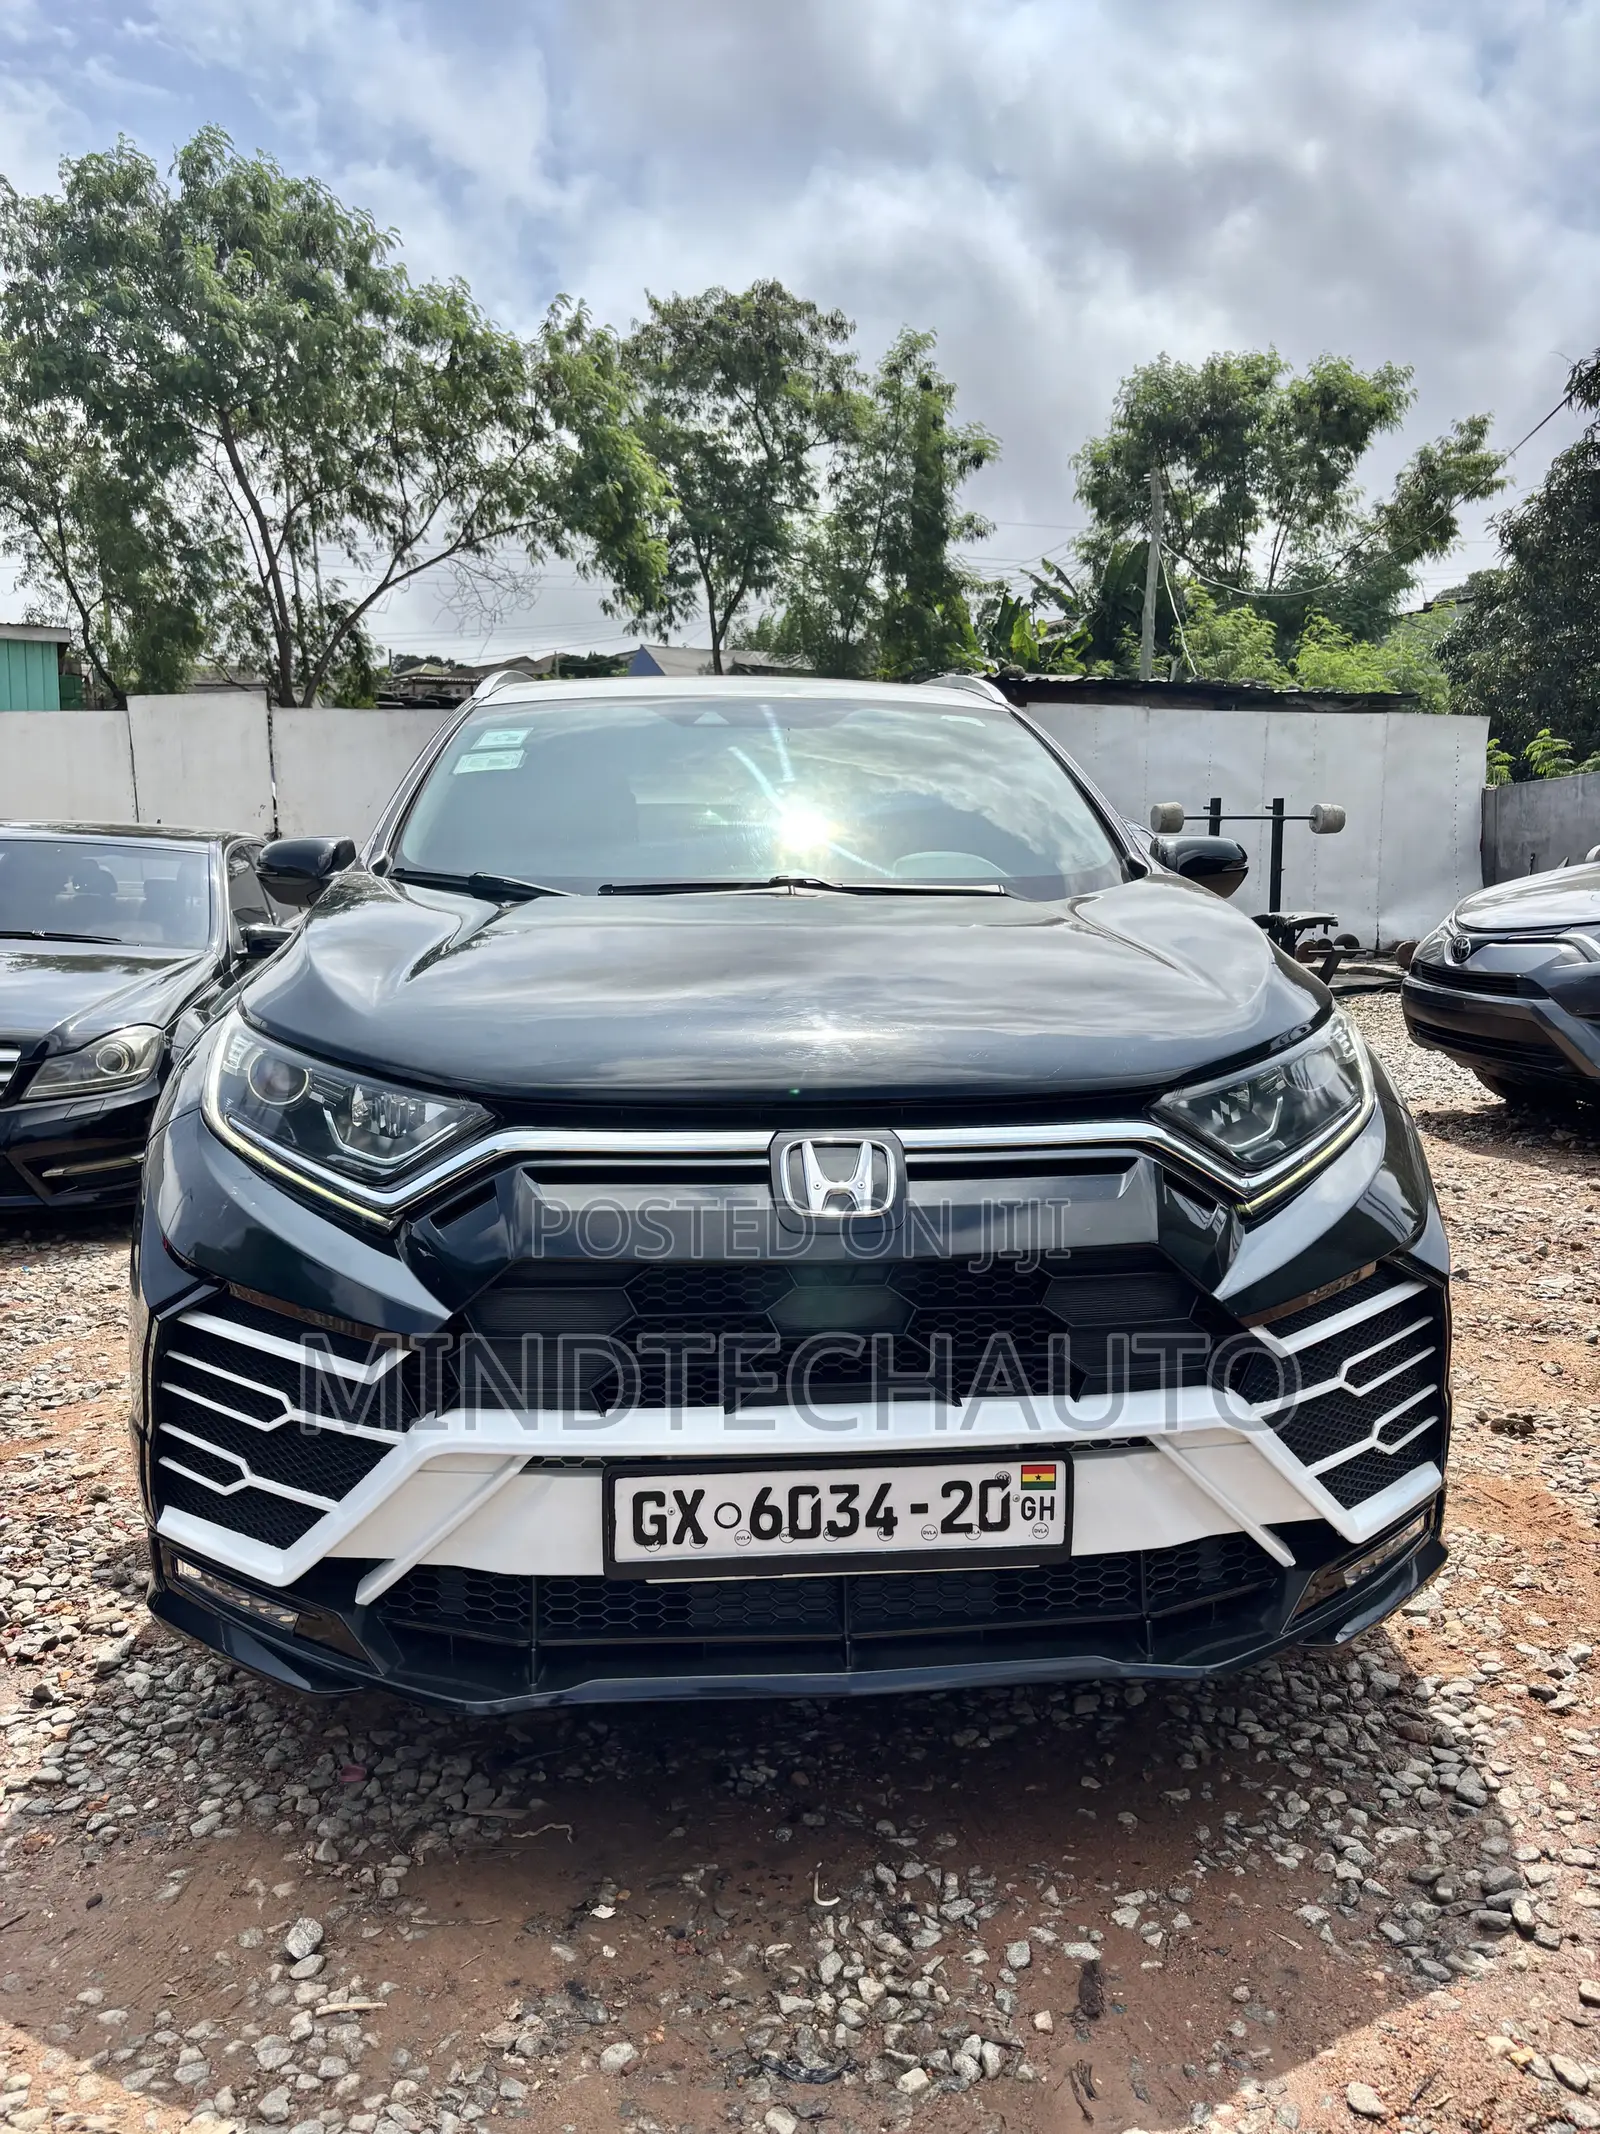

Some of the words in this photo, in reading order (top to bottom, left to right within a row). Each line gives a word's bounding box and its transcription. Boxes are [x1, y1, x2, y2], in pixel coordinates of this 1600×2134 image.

[632, 1488, 709, 1546] GX
[749, 1478, 1011, 1541] 6034-20
[1020, 1495, 1055, 1522] GH
